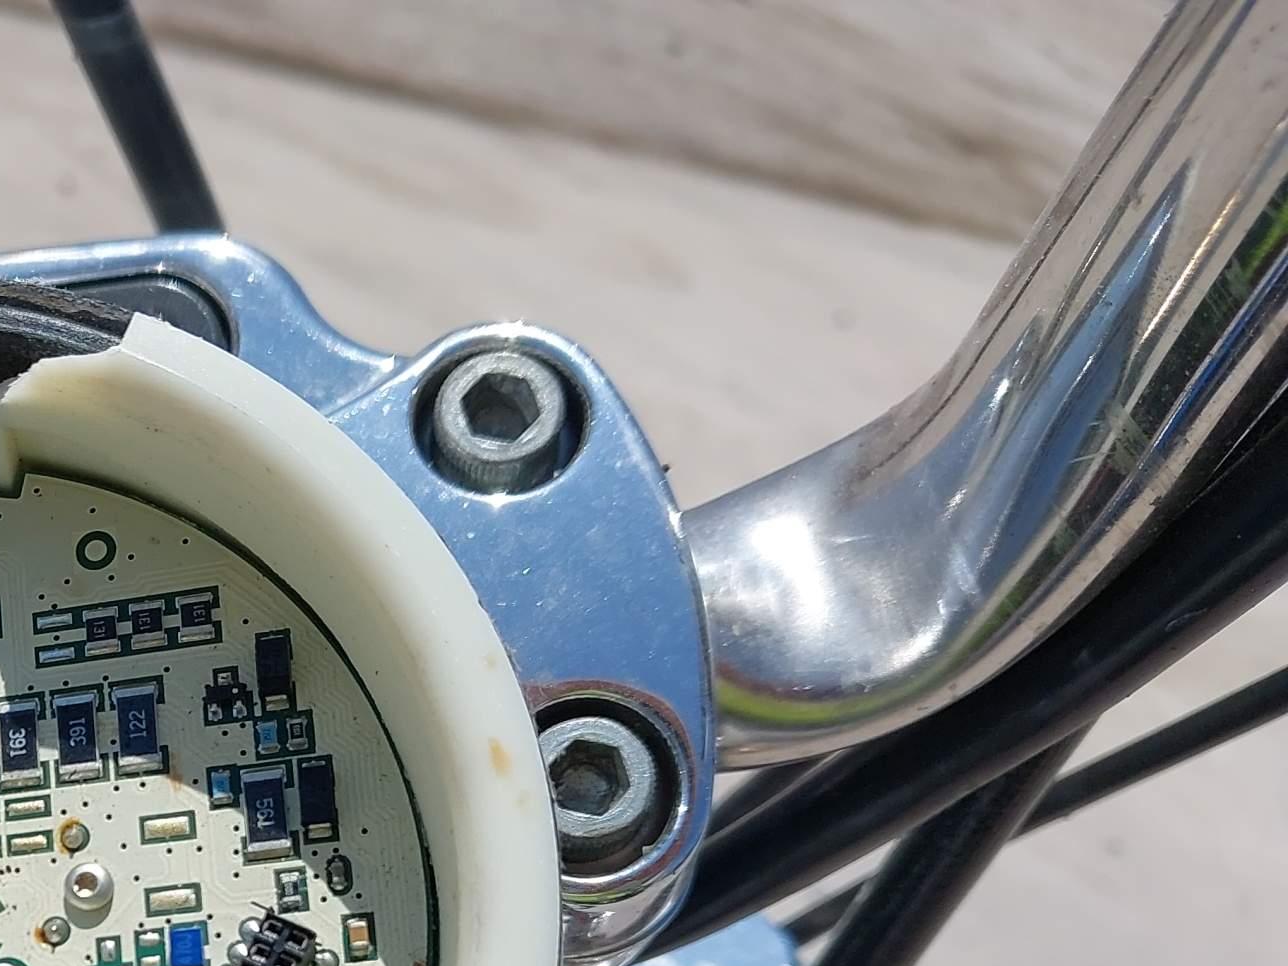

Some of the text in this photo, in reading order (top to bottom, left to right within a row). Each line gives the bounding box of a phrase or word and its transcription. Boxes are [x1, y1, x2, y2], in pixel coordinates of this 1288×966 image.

[69, 716, 88, 747] 391
[128, 708, 147, 739] 122
[9, 726, 27, 758] 391
